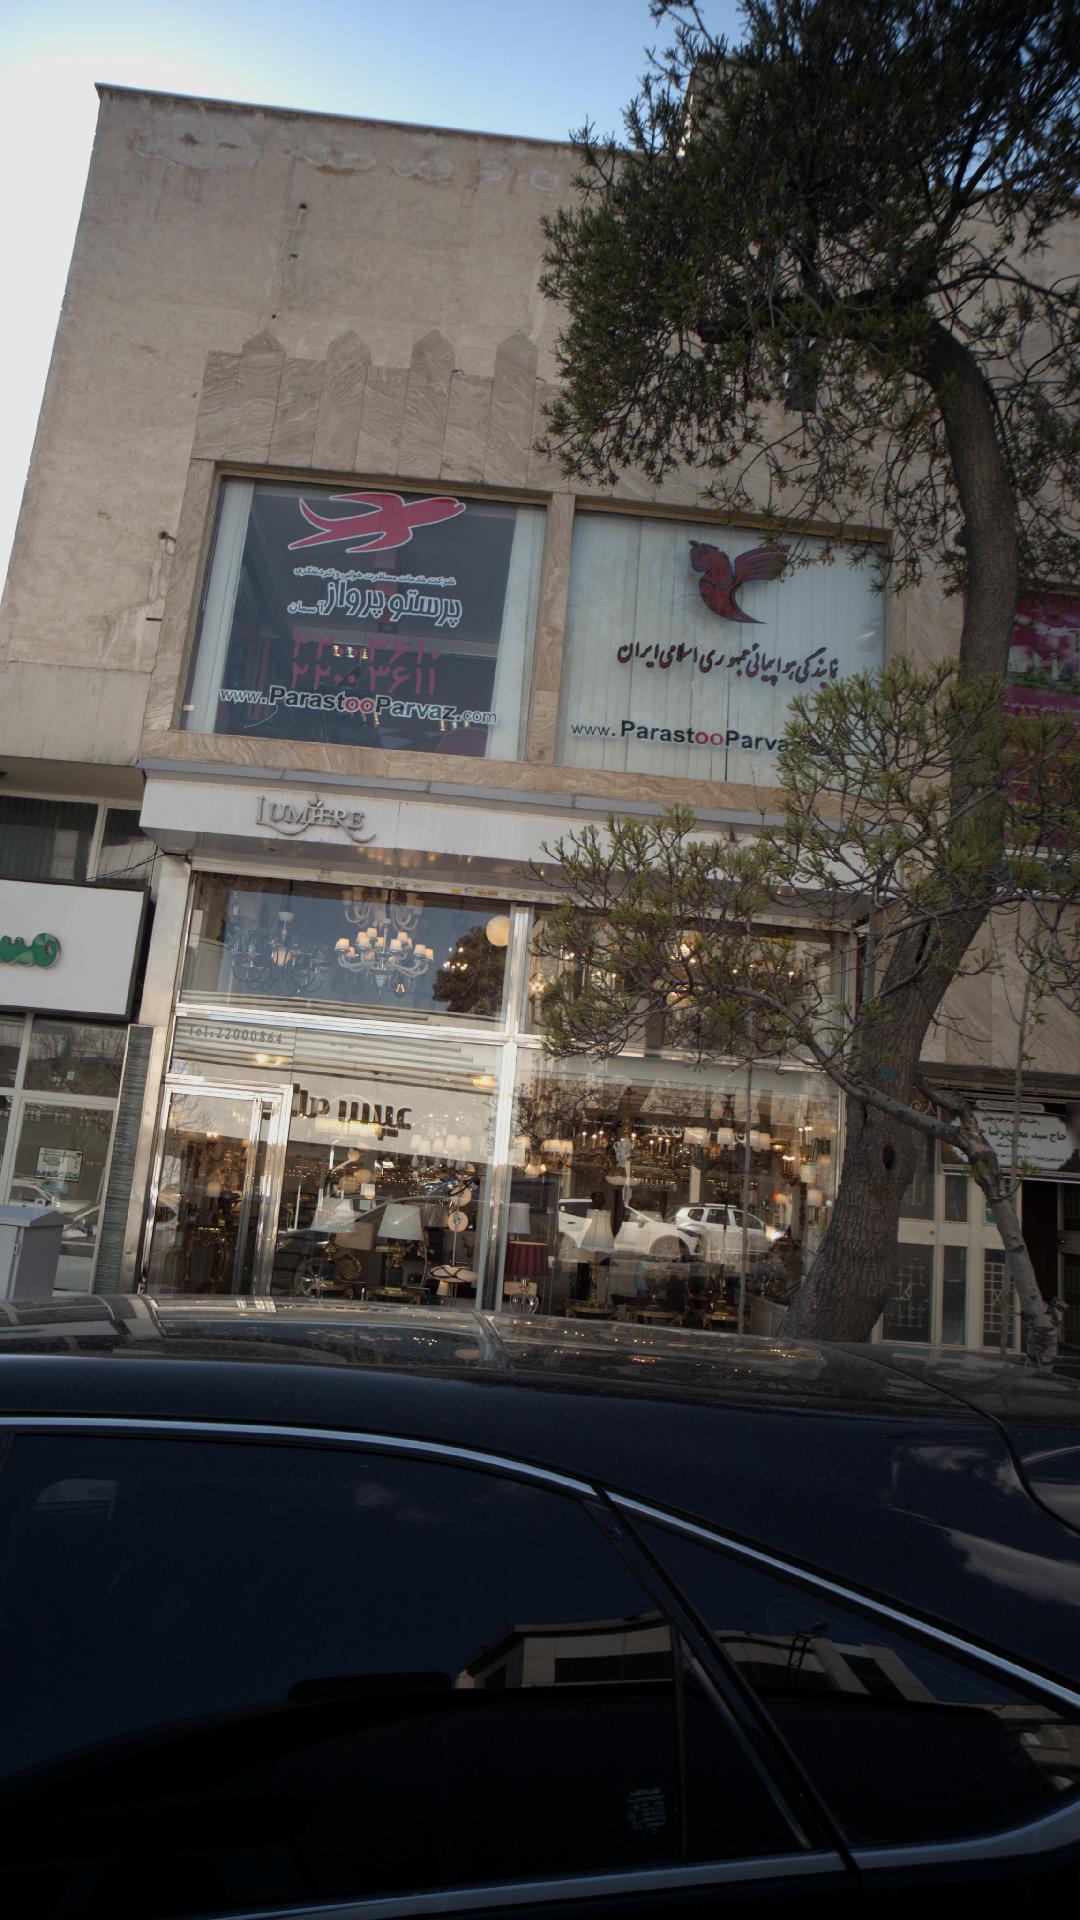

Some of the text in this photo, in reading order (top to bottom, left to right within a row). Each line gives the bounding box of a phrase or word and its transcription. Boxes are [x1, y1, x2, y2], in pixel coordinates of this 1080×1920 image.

[399, 573, 427, 584] خدمات
[427, 576, 457, 587] شرکت
[287, 580, 463, 628] پرستو پرواز آسمان
[617, 641, 660, 668] ایران
[658, 642, 698, 669] اسلامی
[699, 648, 751, 676] جمهوری
[218, 684, 497, 725] www.ParastooParvaz.com
[570, 719, 796, 754] www.ParastooParva
